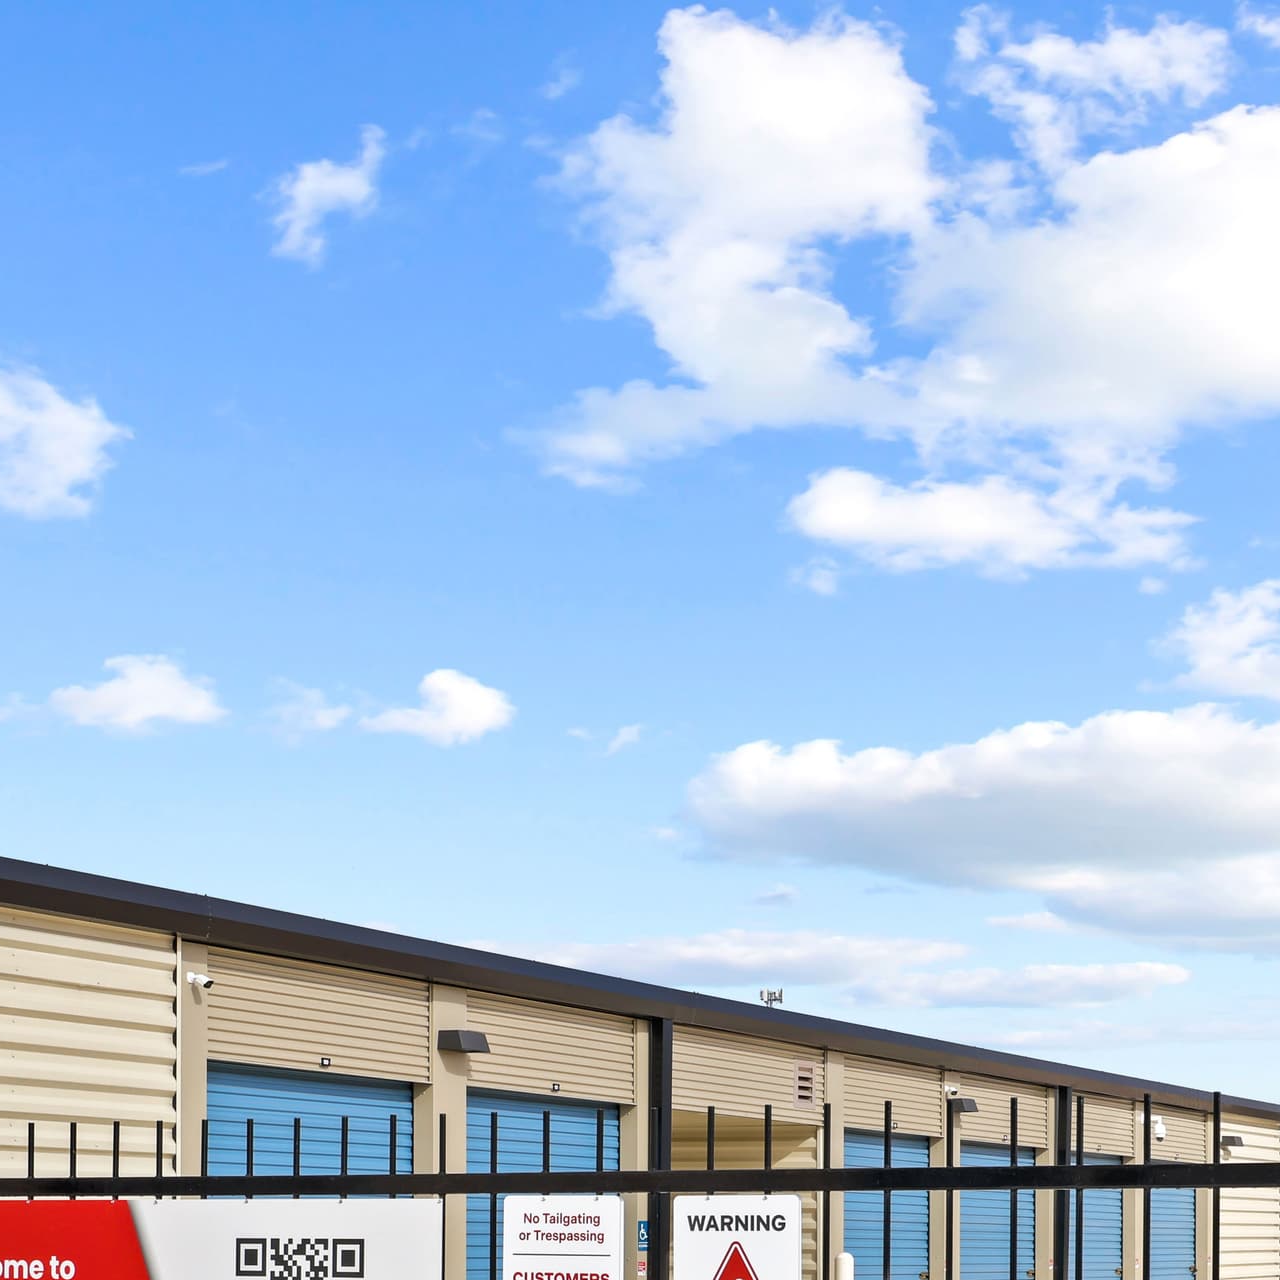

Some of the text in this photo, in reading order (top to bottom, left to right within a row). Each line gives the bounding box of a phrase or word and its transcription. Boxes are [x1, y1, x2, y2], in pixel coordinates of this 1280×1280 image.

[523, 1213, 601, 1227] No Tailgating
[687, 1214, 786, 1232] WARNING
[519, 1230, 605, 1244] or Trespassing
[50, 1255, 76, 1280] to
